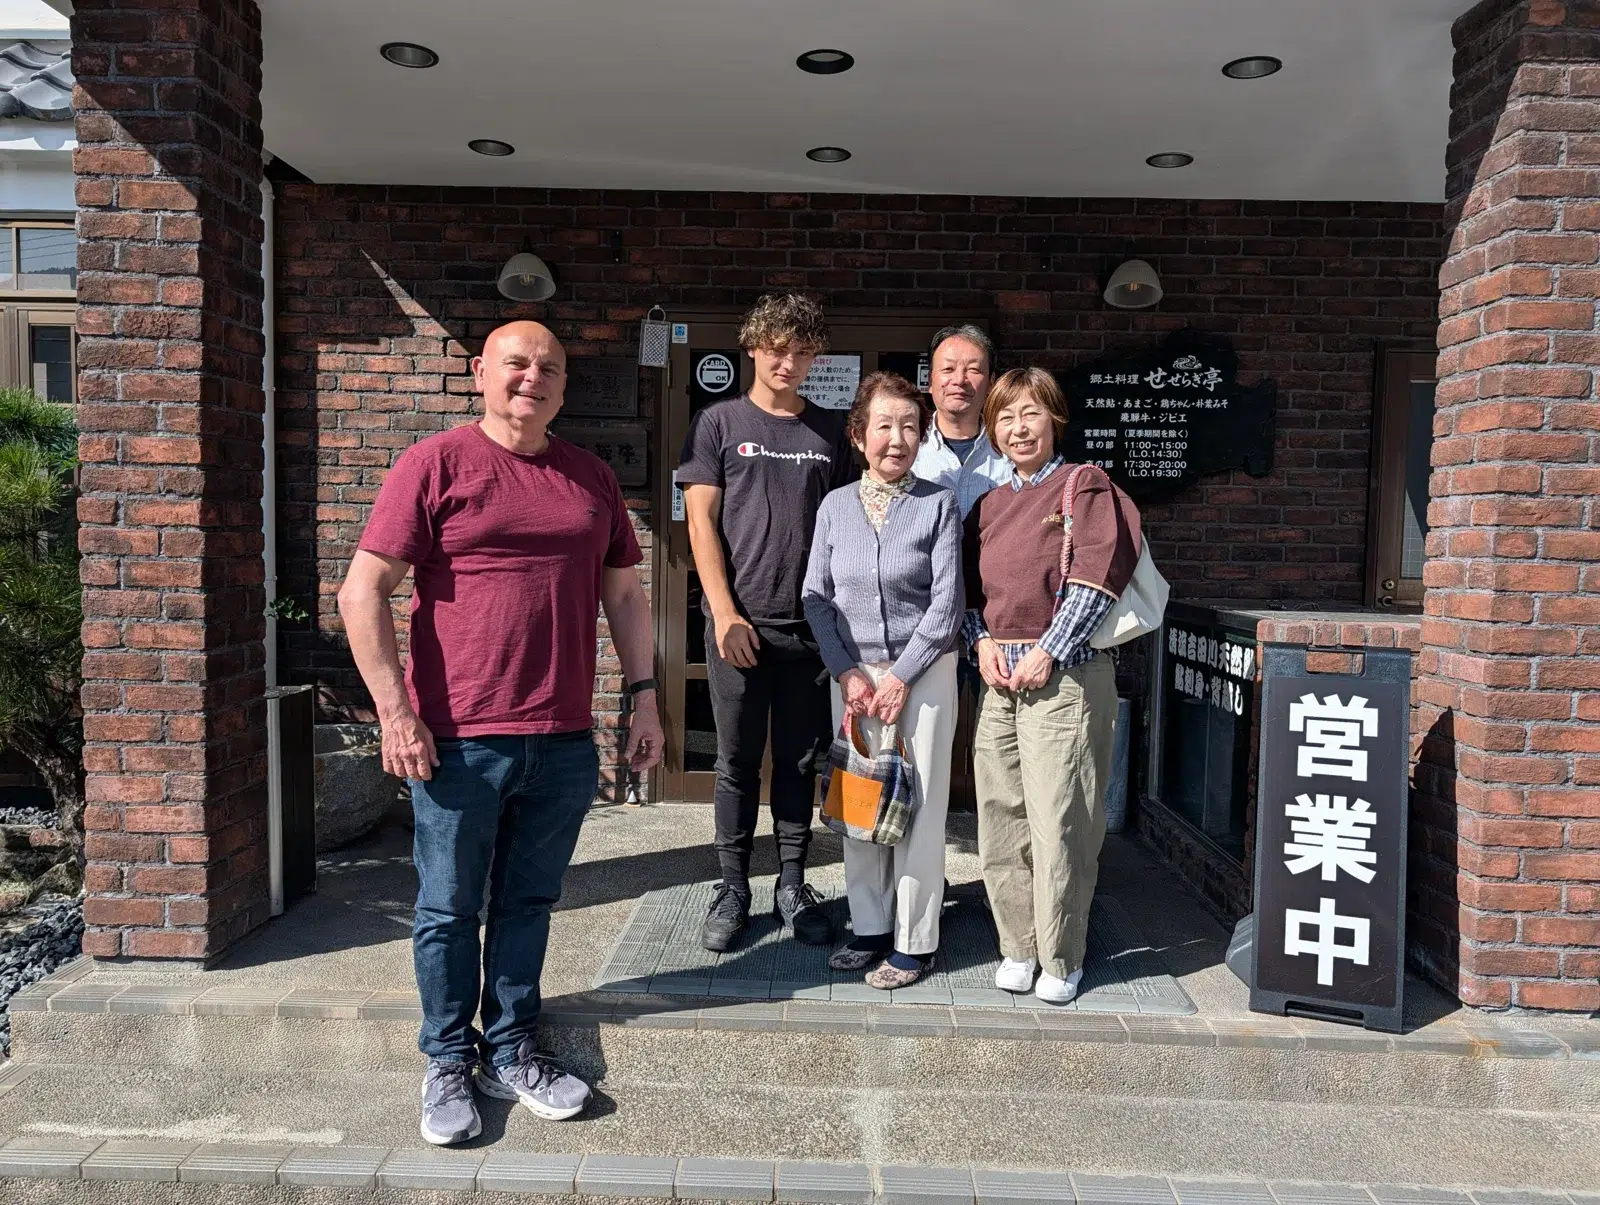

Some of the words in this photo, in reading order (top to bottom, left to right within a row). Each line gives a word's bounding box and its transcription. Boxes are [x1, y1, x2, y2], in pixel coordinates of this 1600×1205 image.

[1089, 373, 1139, 385] 郷土料理
[1143, 366, 1223, 392] せせらぎ亭
[1120, 412, 1187, 423] 飛騨牛・ジビエ
[1084, 429, 1117, 438] 営業時間
[1086, 440, 1114, 449] 昼の部
[737, 442, 832, 465] Champion
[1283, 692, 1379, 986] 営業中
